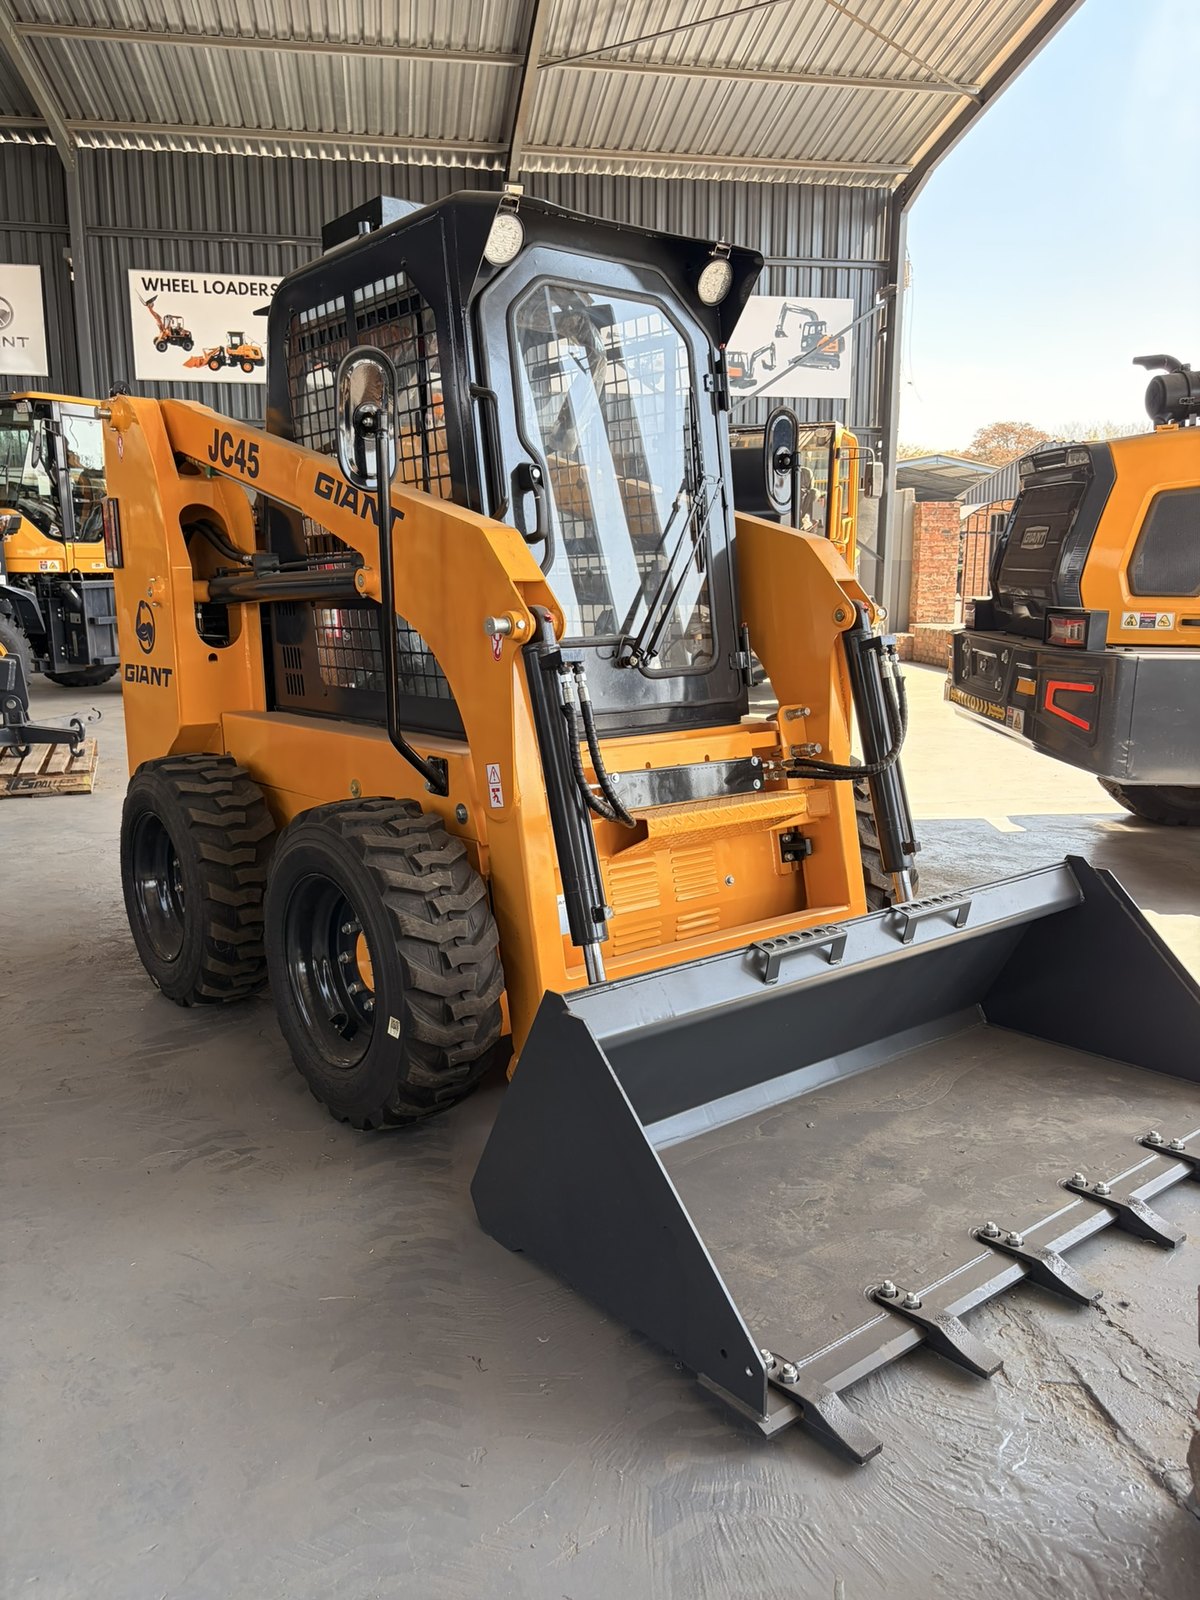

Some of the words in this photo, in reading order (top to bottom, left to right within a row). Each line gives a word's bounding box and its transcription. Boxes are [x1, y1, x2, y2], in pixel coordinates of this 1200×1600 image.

[141, 277, 199, 293] WHEEL
[203, 280, 279, 296] LOADERS
[208, 428, 260, 479] JC45
[314, 471, 405, 531] GIANT
[125, 664, 172, 688] GIANT
